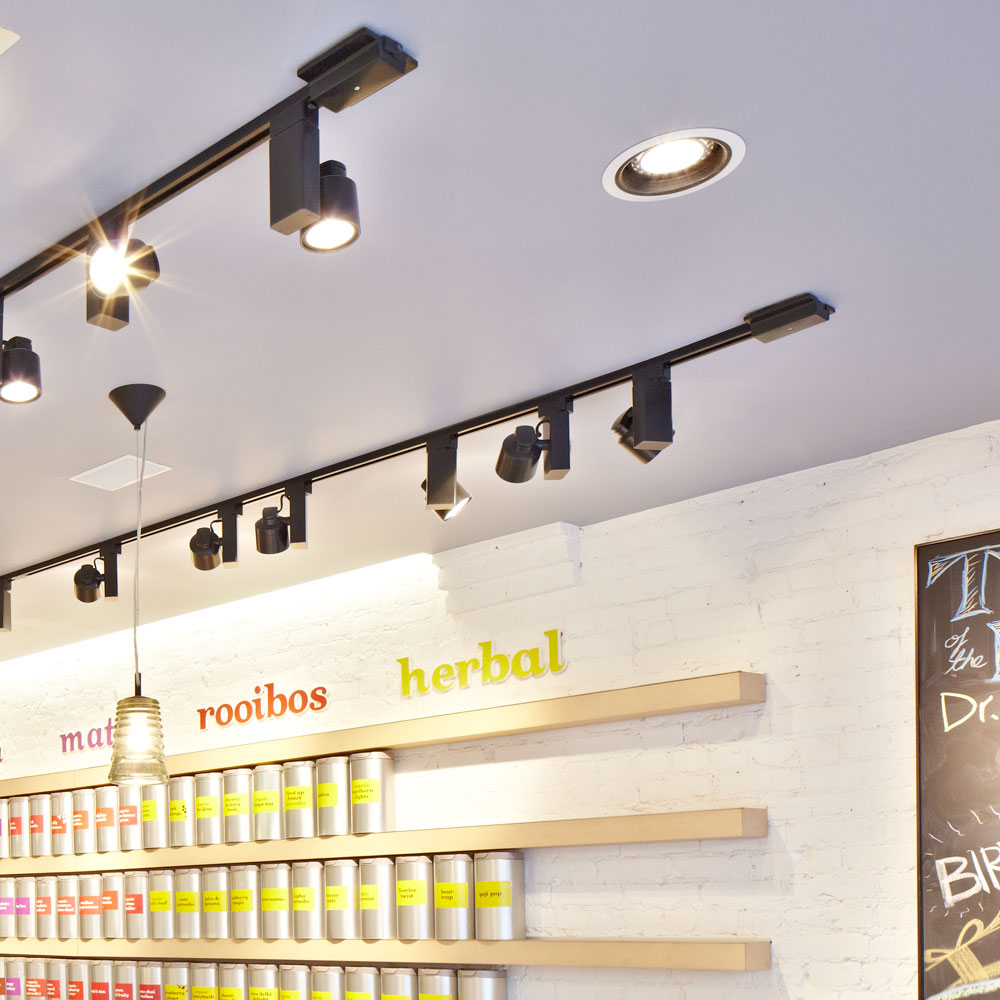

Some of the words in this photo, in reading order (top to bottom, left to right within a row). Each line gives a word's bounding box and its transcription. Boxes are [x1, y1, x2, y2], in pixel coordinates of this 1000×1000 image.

[944, 626, 970, 658] of
[944, 647, 988, 675] the
[396, 628, 566, 697] herbal
[197, 682, 328, 730] rooibos
[940, 692, 1000, 732] Dr.
[60, 717, 115, 753] mat
